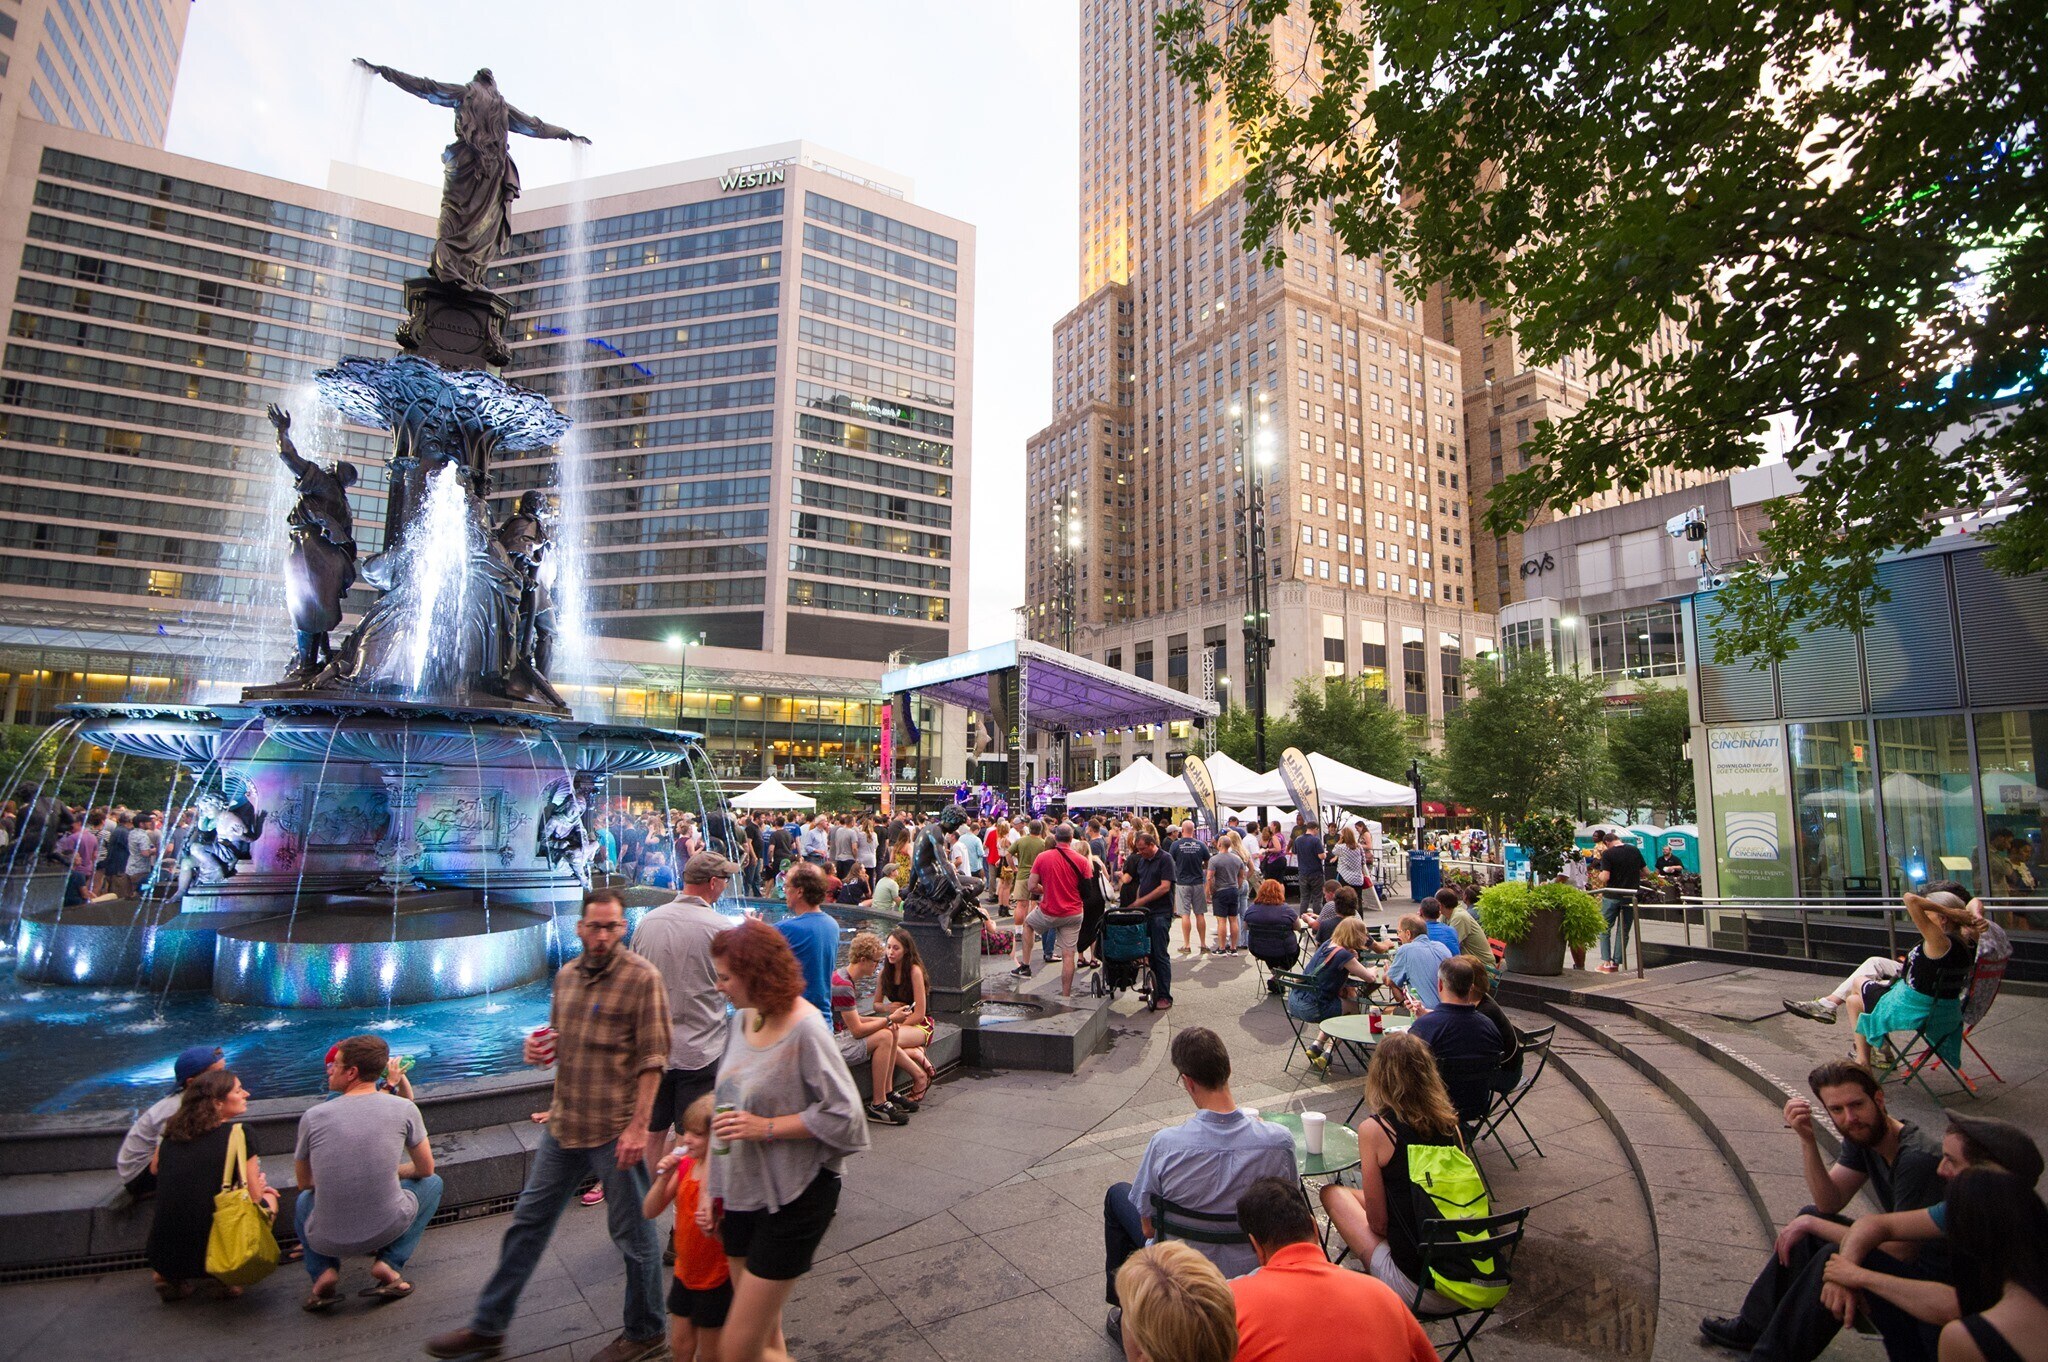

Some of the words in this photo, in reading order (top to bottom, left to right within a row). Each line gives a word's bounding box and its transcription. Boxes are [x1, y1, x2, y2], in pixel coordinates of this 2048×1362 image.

[719, 169, 785, 191] WESTIN
[950, 653, 980, 675] STAGE
[1711, 729, 1765, 741] CONNECT
[1711, 738, 1779, 750] CINCINNATI
[1734, 850, 1772, 858] CINCINNATI
[1724, 868, 1759, 876] ATTRACTIONS
